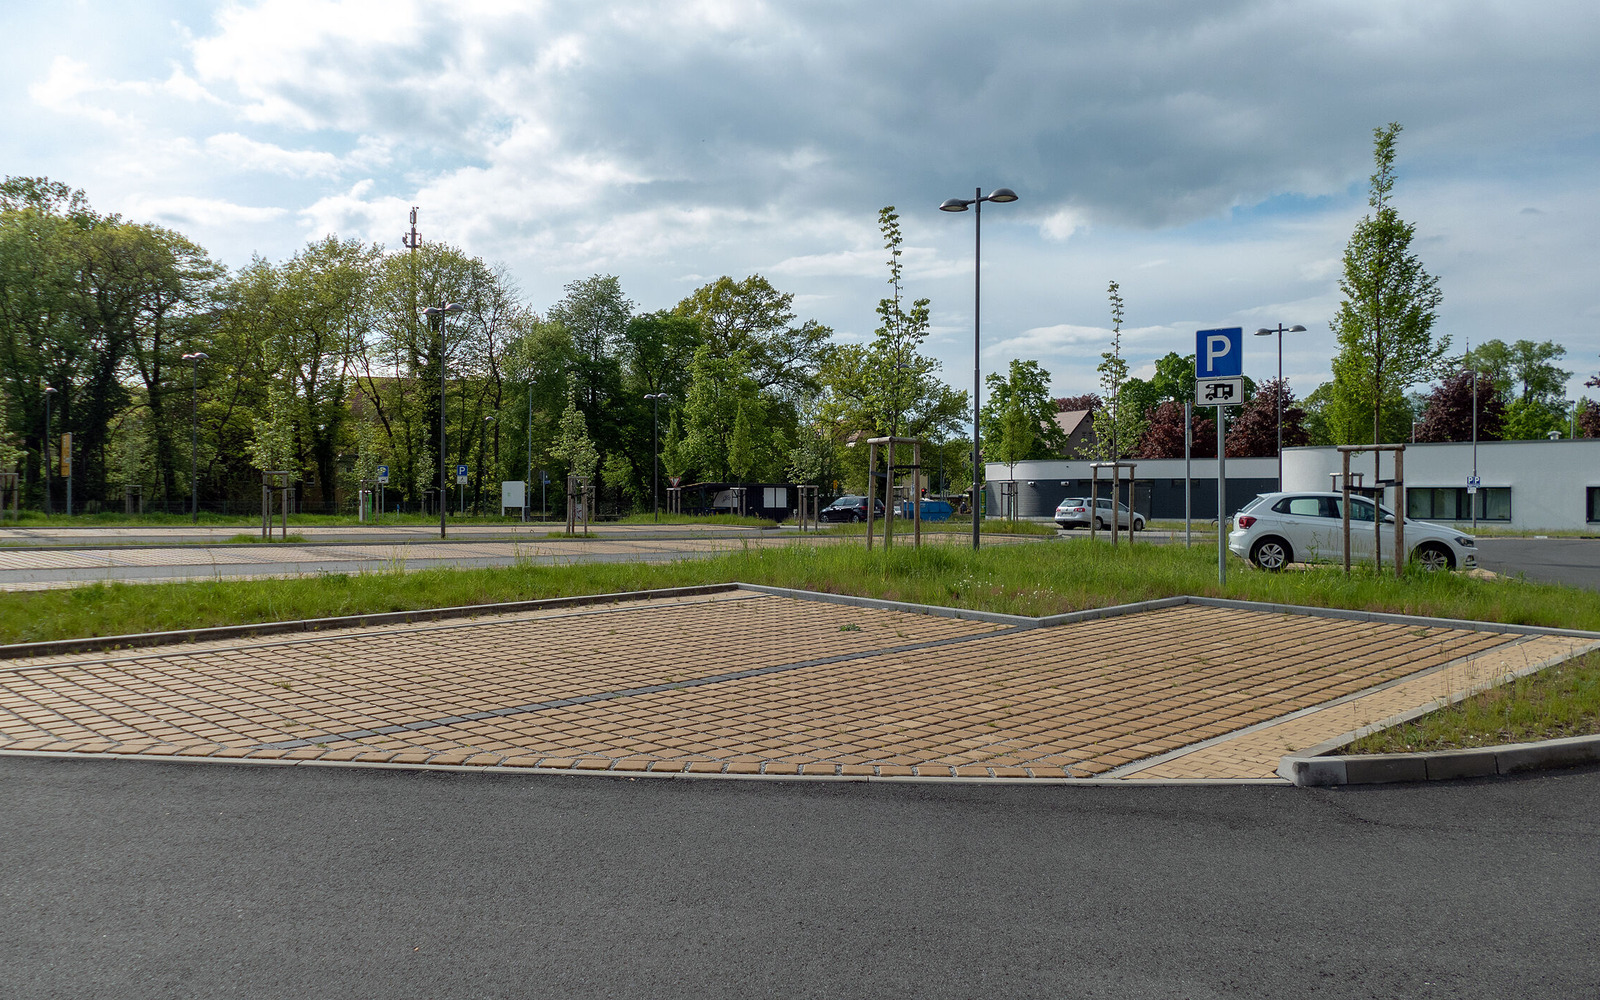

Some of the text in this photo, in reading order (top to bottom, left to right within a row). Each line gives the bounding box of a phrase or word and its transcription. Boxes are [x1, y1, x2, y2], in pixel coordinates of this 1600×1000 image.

[1206, 334, 1232, 372] P
[459, 466, 466, 475] P
[1468, 476, 1473, 484] P
[1474, 476, 1480, 484] P
